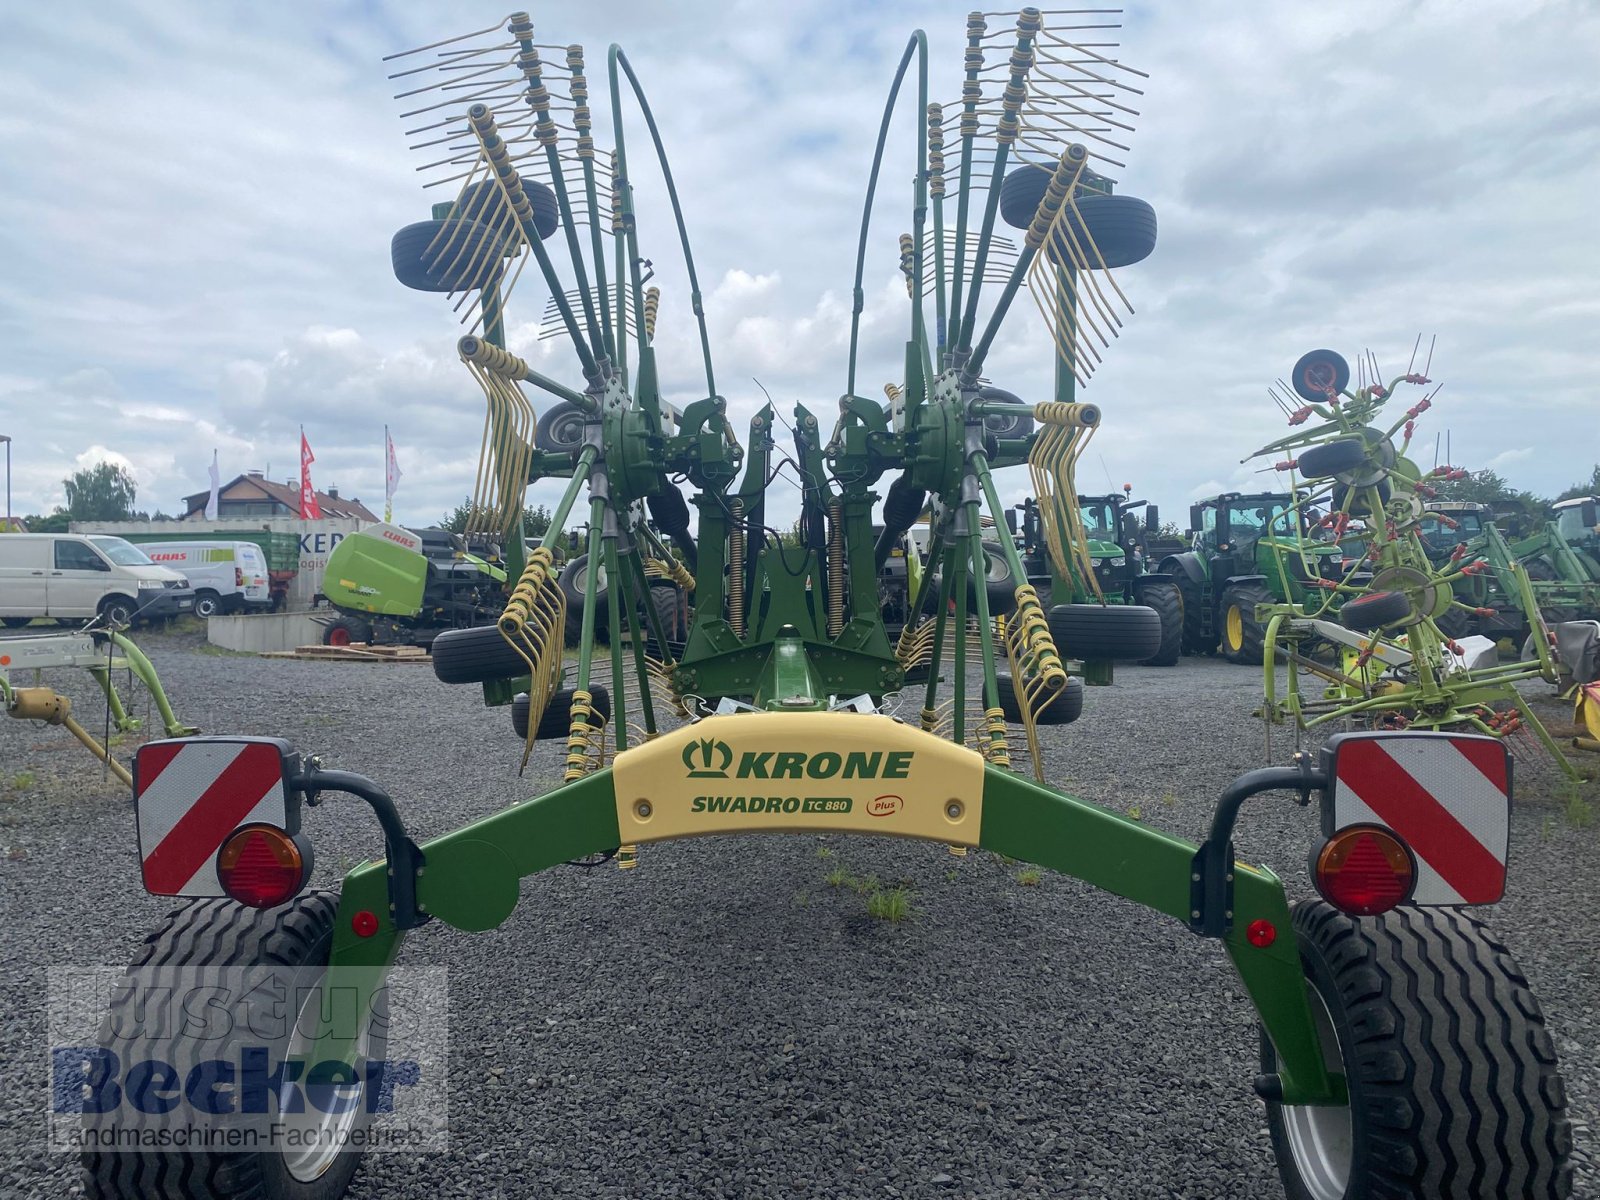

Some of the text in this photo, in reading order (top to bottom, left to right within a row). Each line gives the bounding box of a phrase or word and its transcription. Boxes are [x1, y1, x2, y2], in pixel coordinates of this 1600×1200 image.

[383, 530, 416, 549] CLAAS
[150, 552, 187, 561] CLAAS
[735, 751, 915, 780] KRONE
[691, 796, 848, 813] SWADRO TC 880
[874, 801, 896, 811] Plus
